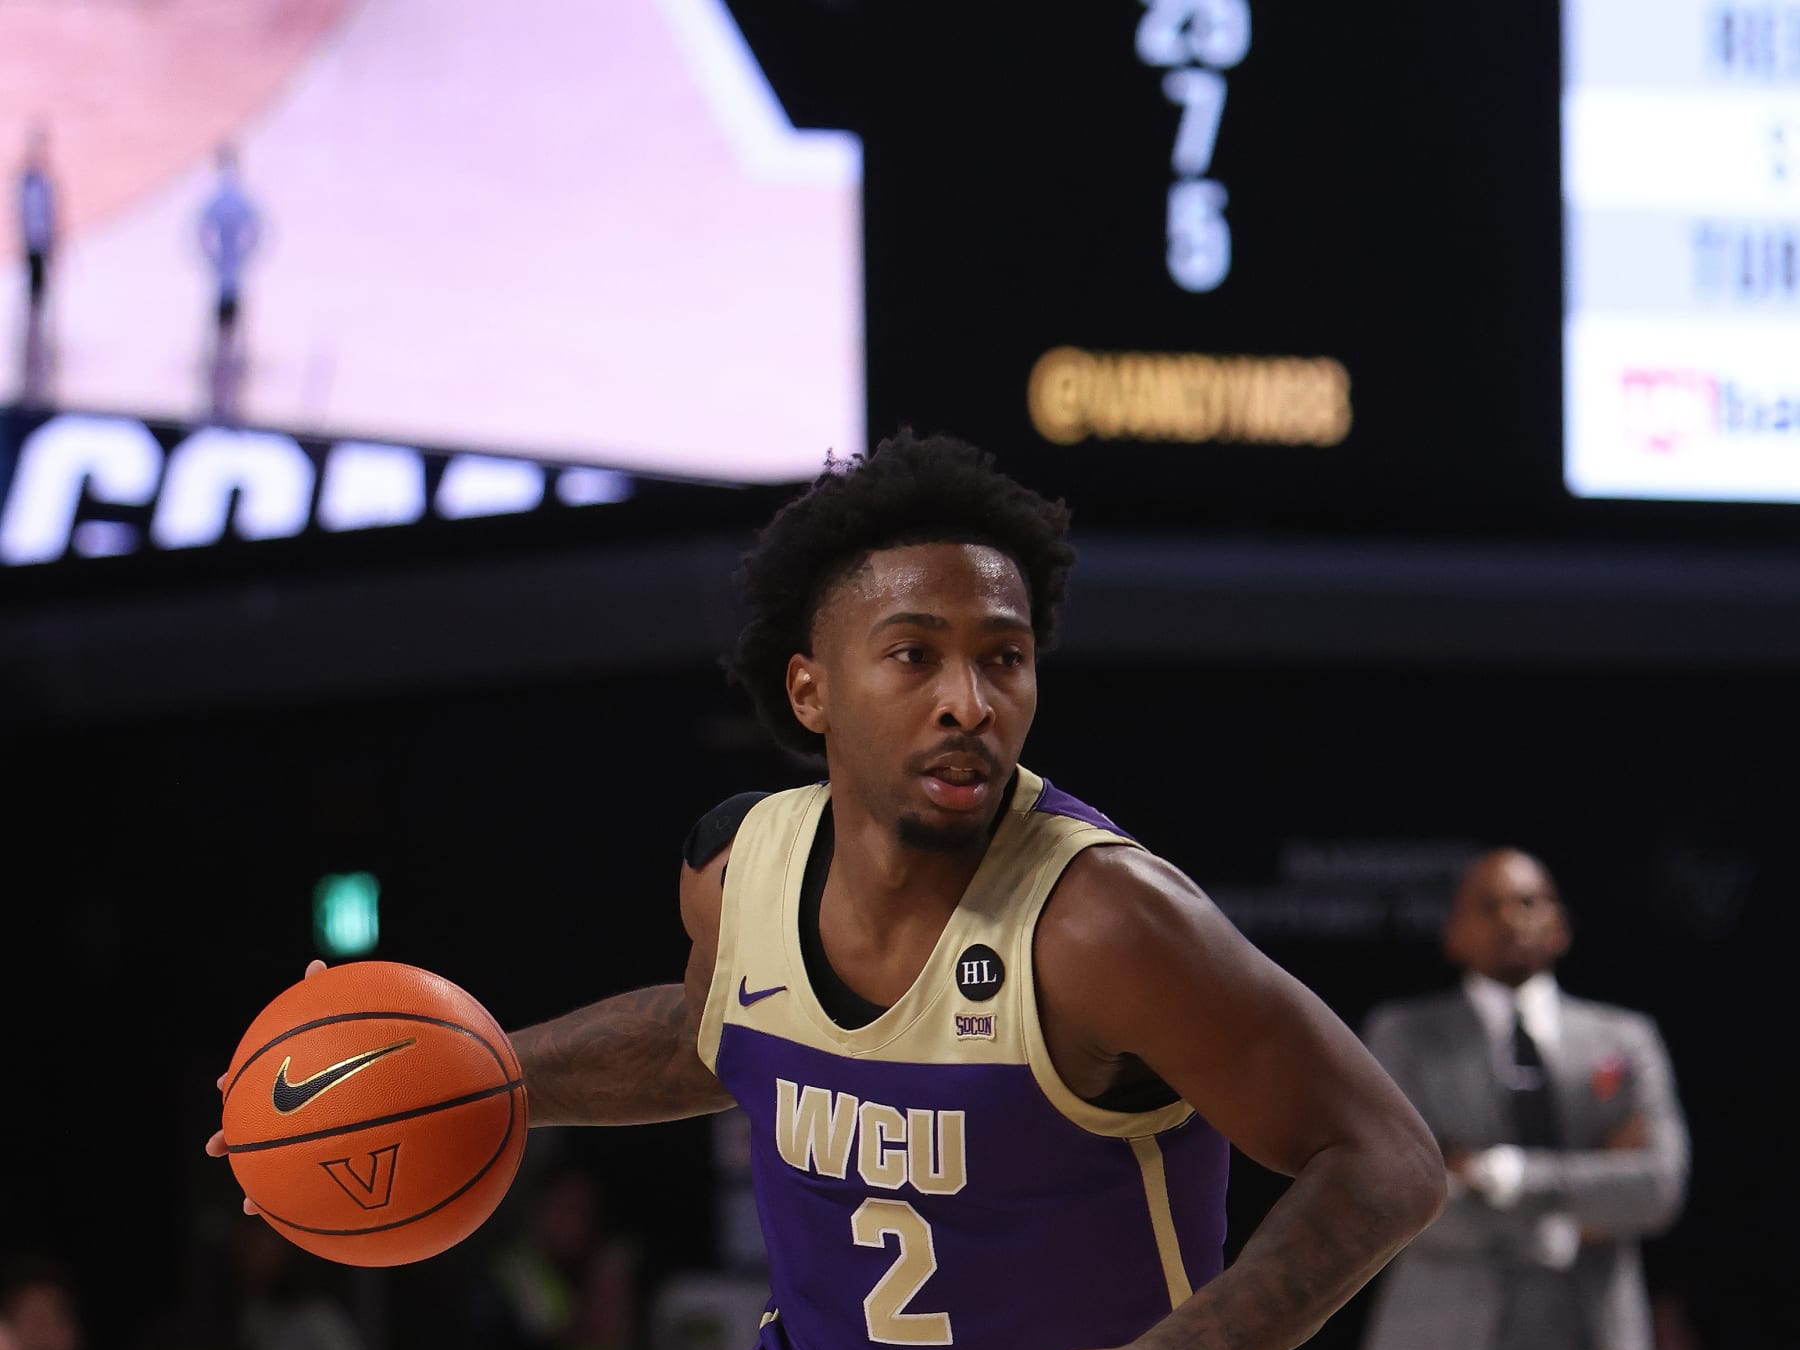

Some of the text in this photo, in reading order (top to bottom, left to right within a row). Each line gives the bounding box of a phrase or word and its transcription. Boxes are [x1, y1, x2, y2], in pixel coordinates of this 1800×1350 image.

[1161, 68, 1227, 177] 7
[961, 959, 998, 985] HL
[955, 1014, 993, 1036] SOCON
[319, 1142, 401, 1211] V
[775, 1078, 967, 1195] WCU
[850, 1197, 954, 1346] 2
